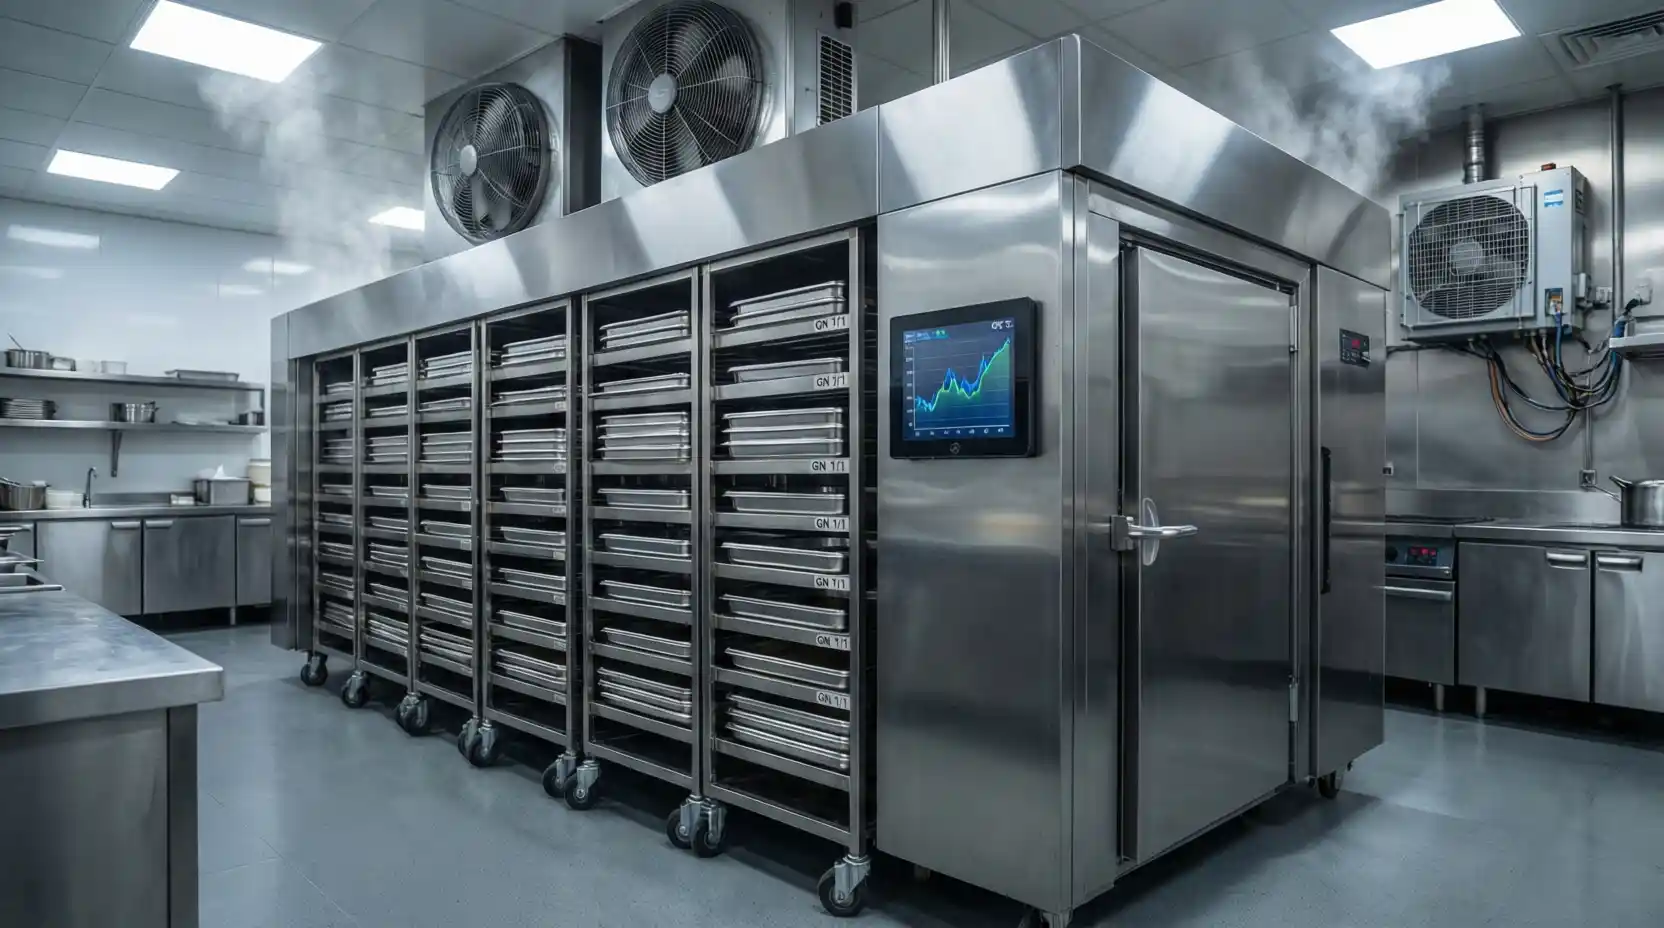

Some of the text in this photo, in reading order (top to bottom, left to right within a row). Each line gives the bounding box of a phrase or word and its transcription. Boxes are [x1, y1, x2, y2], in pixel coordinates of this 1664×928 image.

[815, 319, 828, 330] GN
[816, 376, 830, 386] GN
[812, 461, 826, 470] GN
[816, 518, 845, 530] GN 1/1
[816, 578, 828, 587] GN
[818, 692, 832, 704] GN
